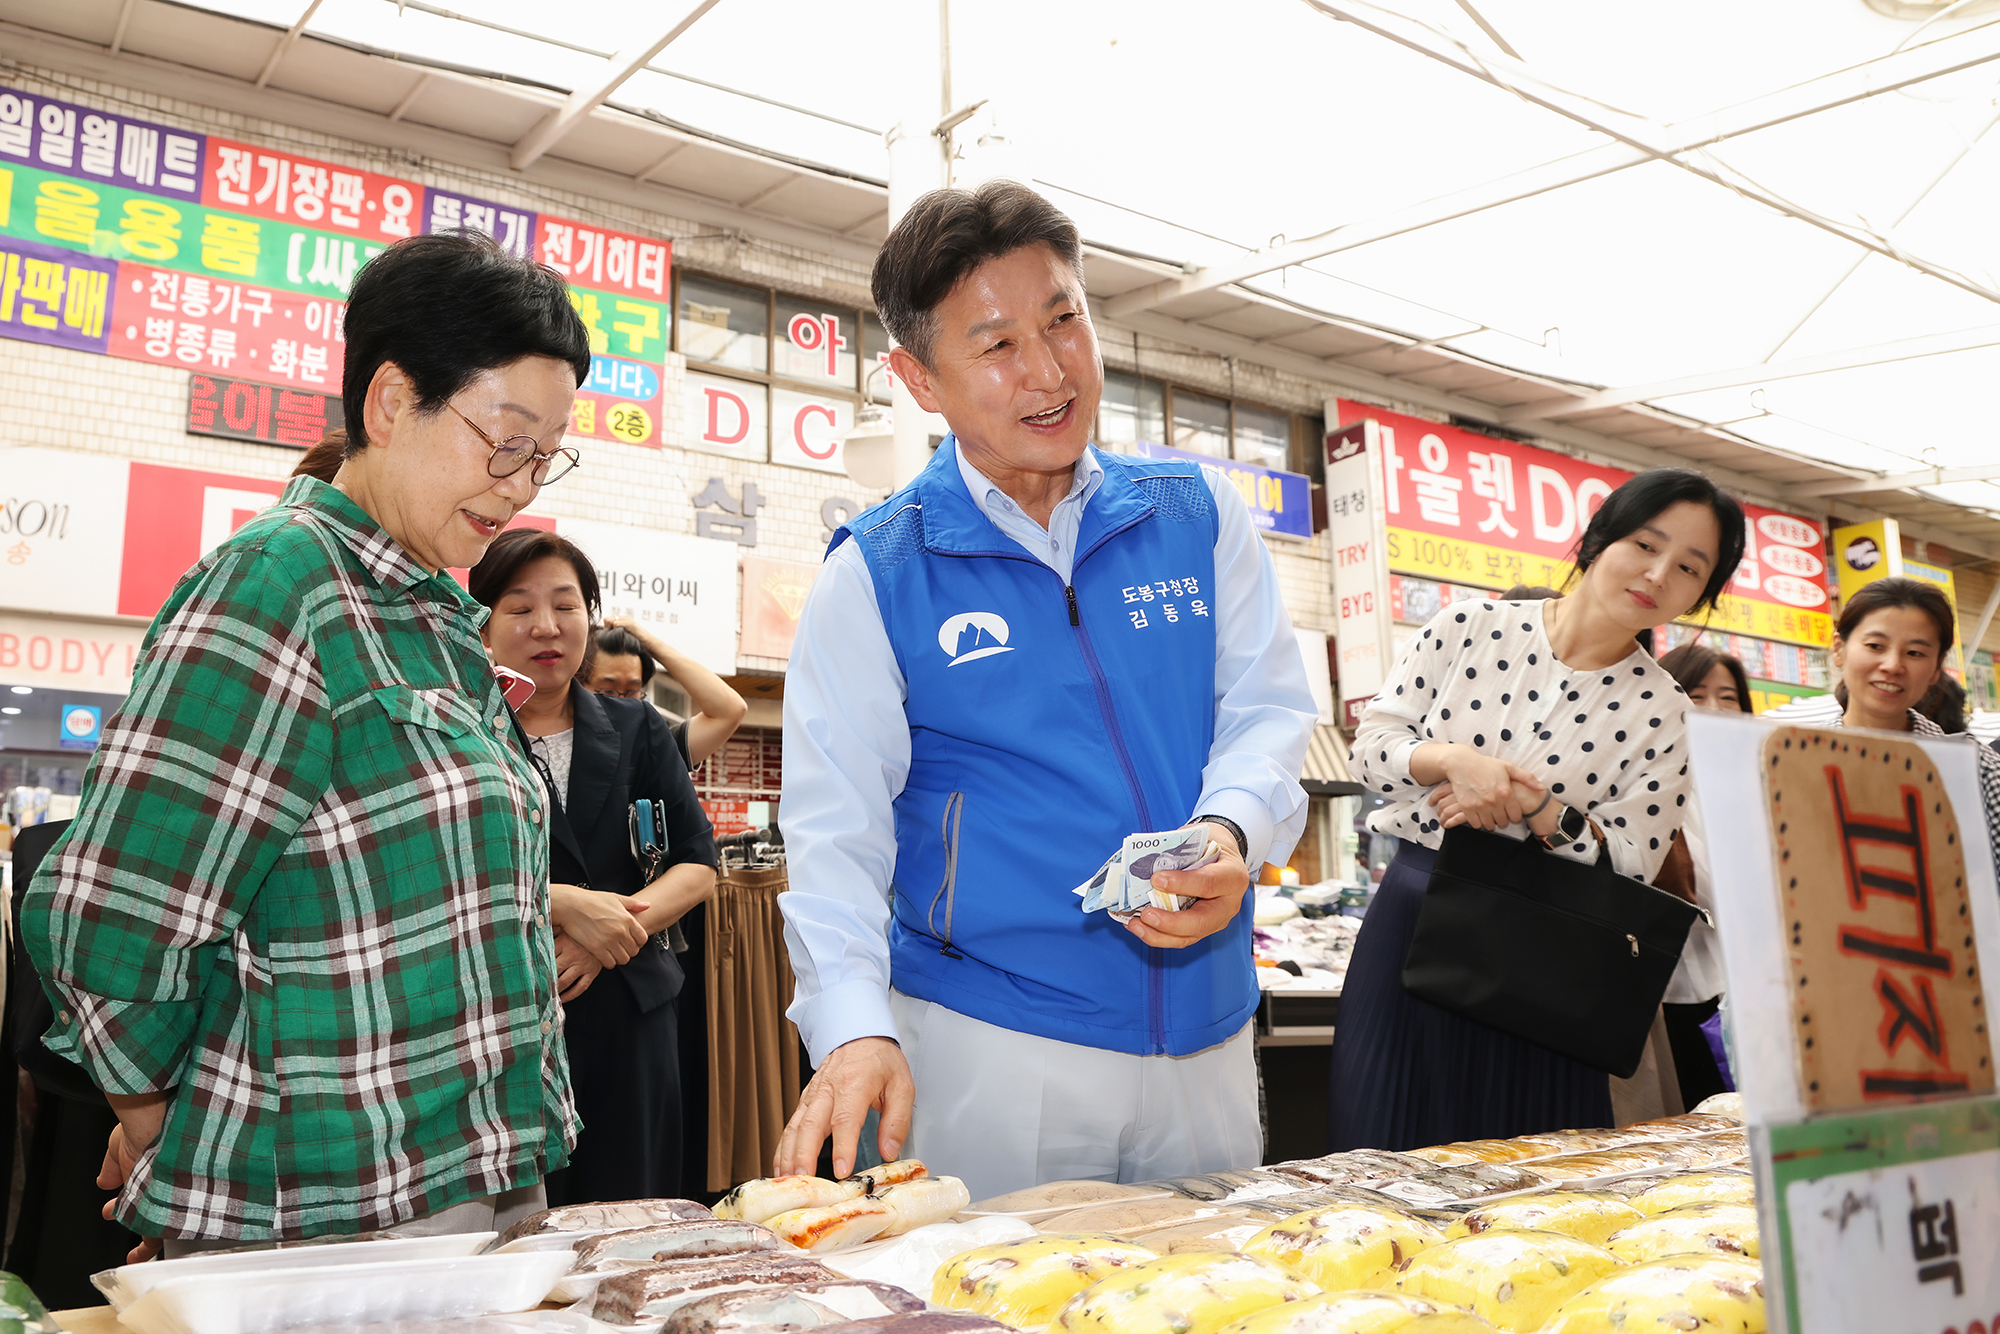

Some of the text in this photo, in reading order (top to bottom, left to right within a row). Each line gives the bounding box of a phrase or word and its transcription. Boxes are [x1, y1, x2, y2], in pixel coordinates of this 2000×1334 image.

[0, 167, 261, 277] 울용품
[542, 222, 667, 295] 전기히터
[149, 270, 273, 328] 전통가구
[144, 316, 329, 384] 병종류 화분
[584, 359, 652, 398] 니다.
[612, 410, 645, 439] 2층
[1333, 489, 1367, 516] 태창
[7, 540, 31, 565] 송
[1337, 542, 1370, 568] TRY
[1413, 537, 1473, 572] 100%
[1485, 551, 1524, 585] 보장
[597, 571, 697, 606] 비와이씨
[1121, 577, 1200, 605] 도봉구청장
[1342, 592, 1374, 618] BYC
[0, 632, 115, 677] BODY
[1132, 838, 1160, 850] 1000
